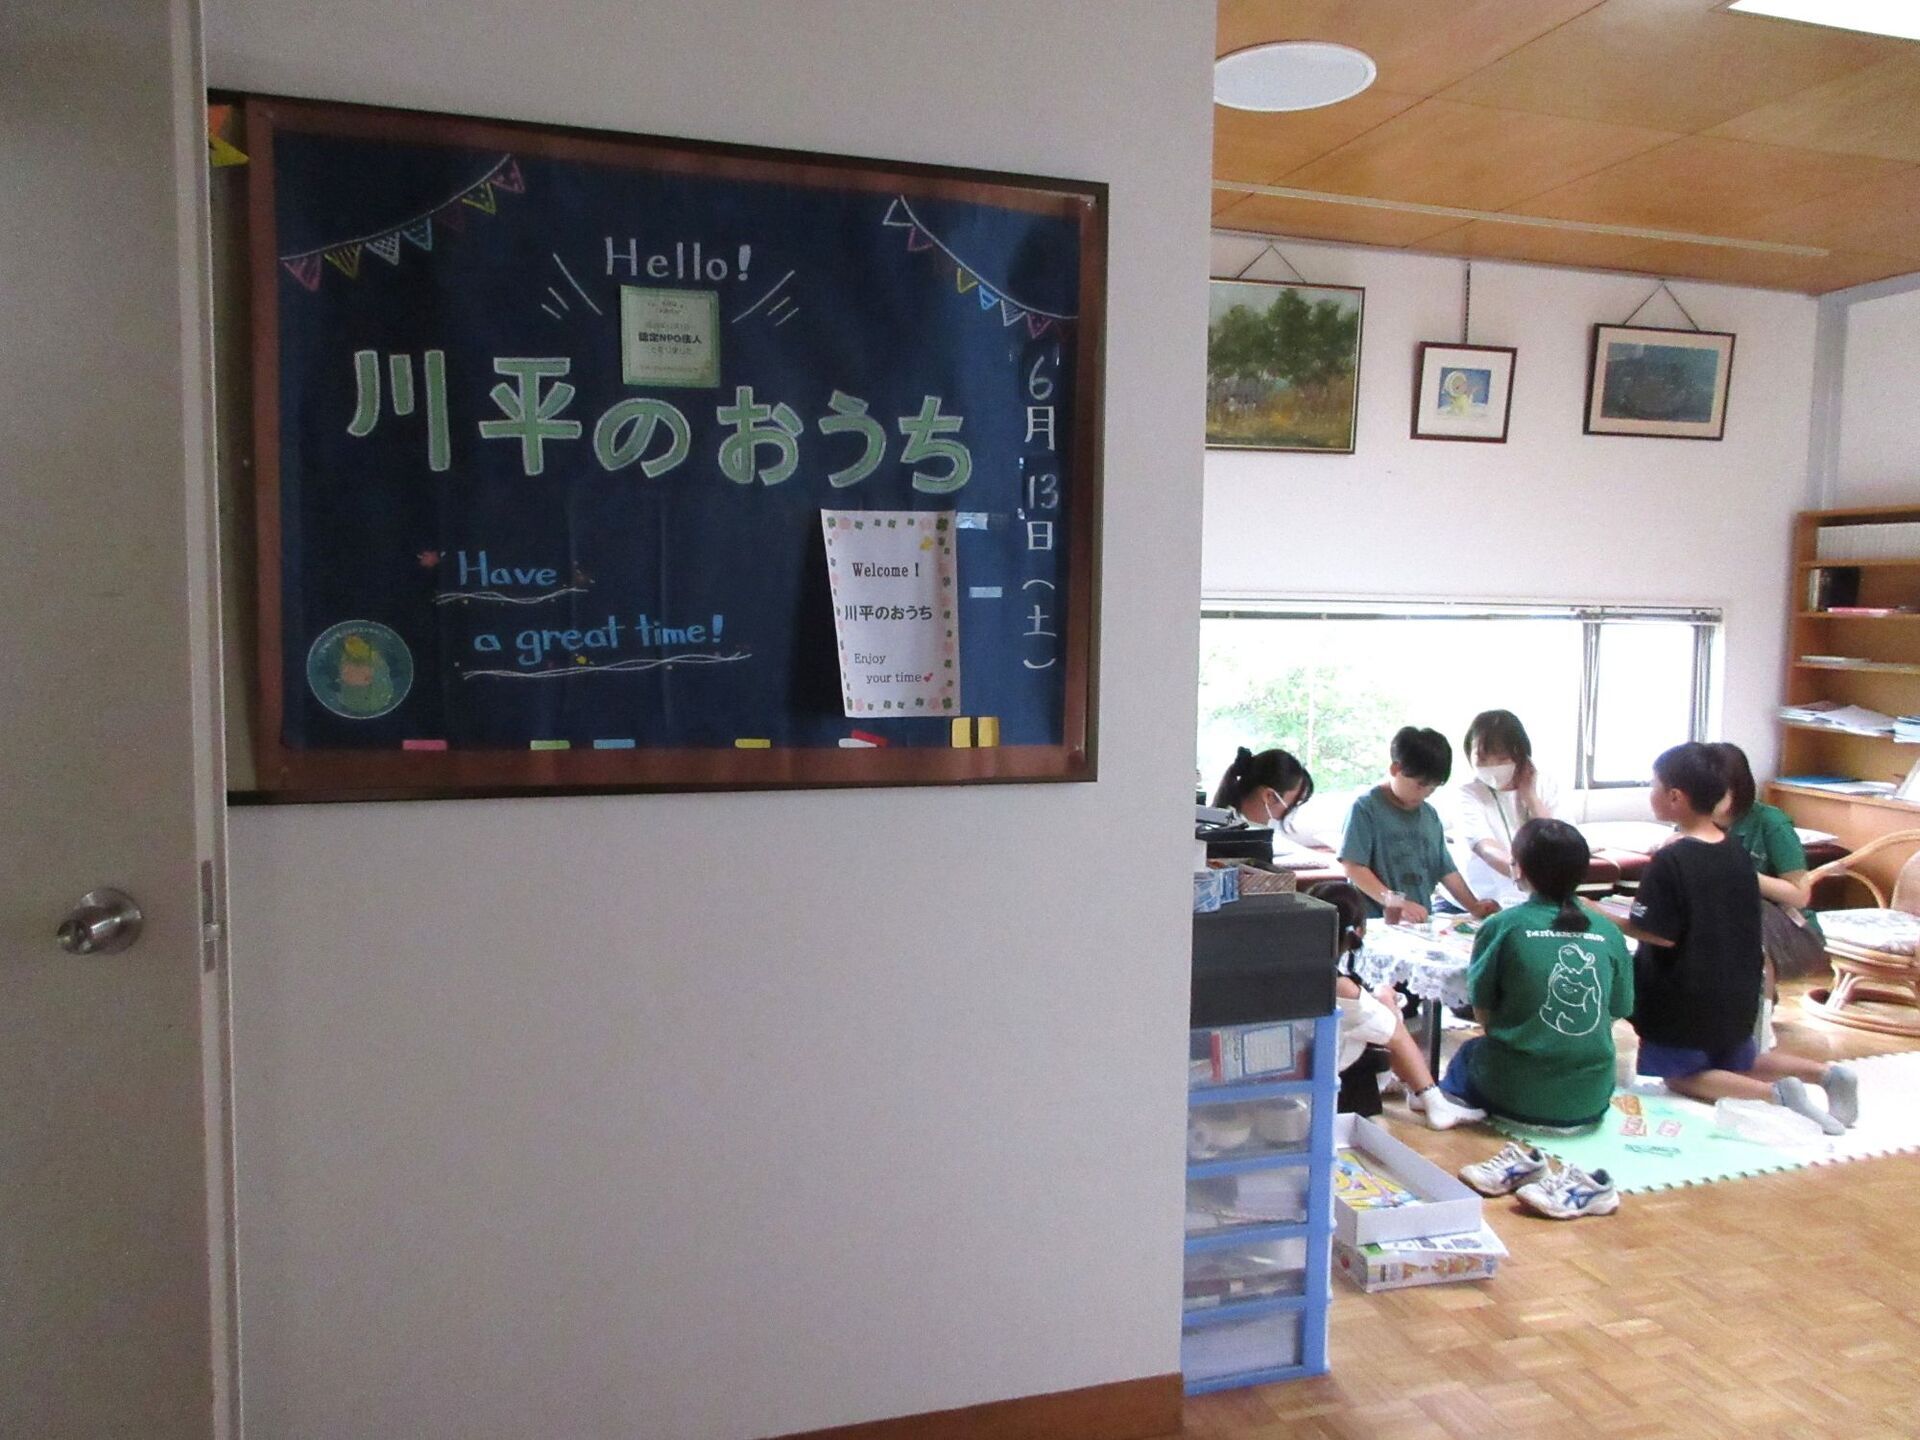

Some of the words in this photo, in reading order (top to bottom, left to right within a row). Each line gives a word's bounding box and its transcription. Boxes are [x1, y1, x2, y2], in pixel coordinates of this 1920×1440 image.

[604, 236, 752, 282] Hello!
[346, 349, 973, 494] 川平のおうち
[457, 550, 559, 587] Have
[845, 604, 933, 622] 川平のおうち
[473, 630, 502, 653] a
[516, 615, 630, 666] great
[634, 613, 725, 647] time!
[854, 652, 887, 666] Enjoy
[865, 673, 892, 684] your
[894, 670, 923, 684] time
